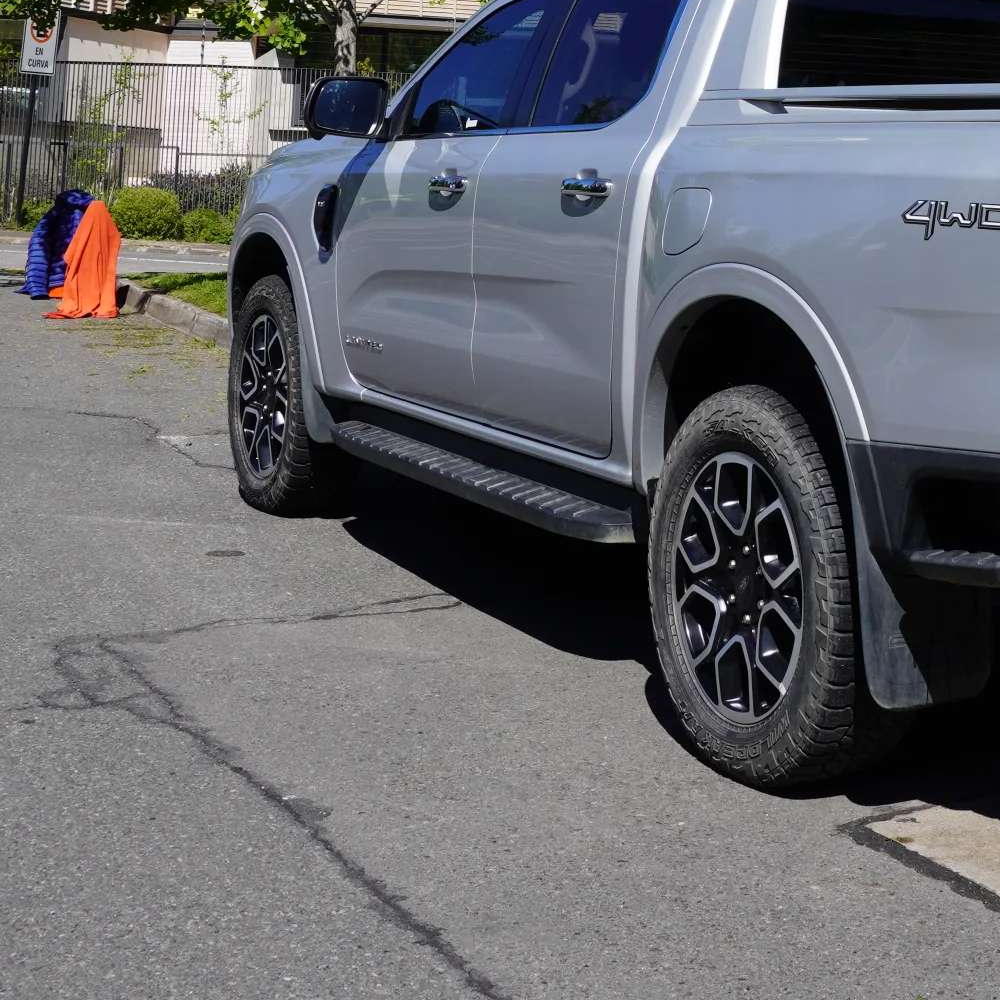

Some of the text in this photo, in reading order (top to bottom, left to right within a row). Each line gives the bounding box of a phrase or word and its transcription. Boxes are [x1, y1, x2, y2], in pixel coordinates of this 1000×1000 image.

[35, 47, 43, 56] EN
[27, 58, 49, 68] CURVA
[703, 419, 779, 468] FALKEN
